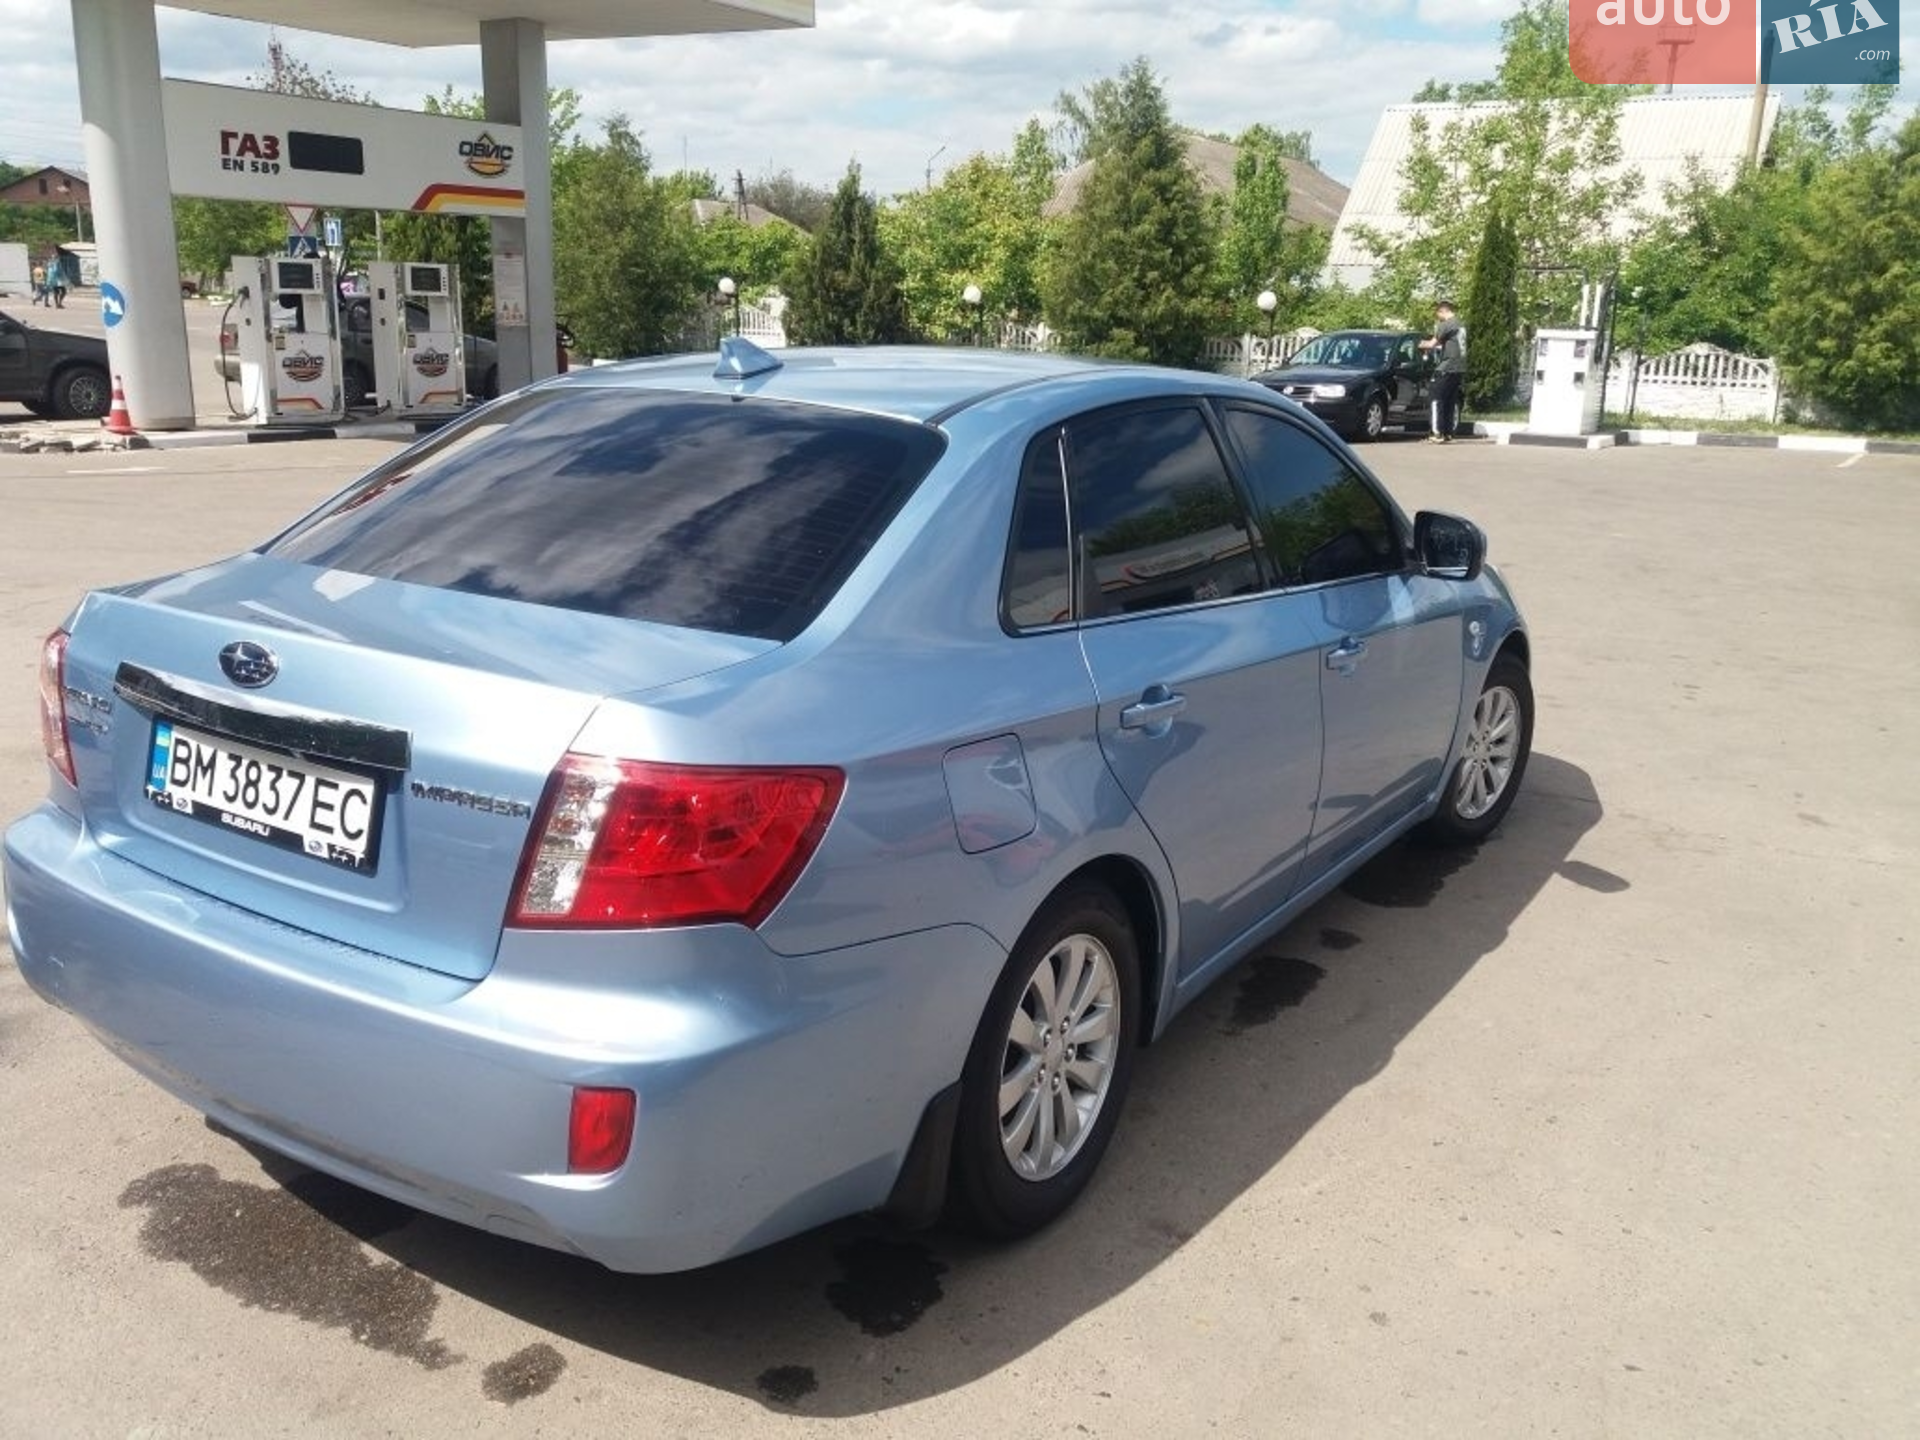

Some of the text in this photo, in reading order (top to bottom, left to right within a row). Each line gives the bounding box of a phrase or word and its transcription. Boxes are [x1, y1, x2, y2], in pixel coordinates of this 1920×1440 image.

[220, 130, 280, 161] ГАЗ
[459, 140, 514, 161] ОВИС
[221, 158, 280, 175] EN 589
[170, 737, 368, 841] BM 3837 EC
[220, 812, 271, 837] SUBARU
